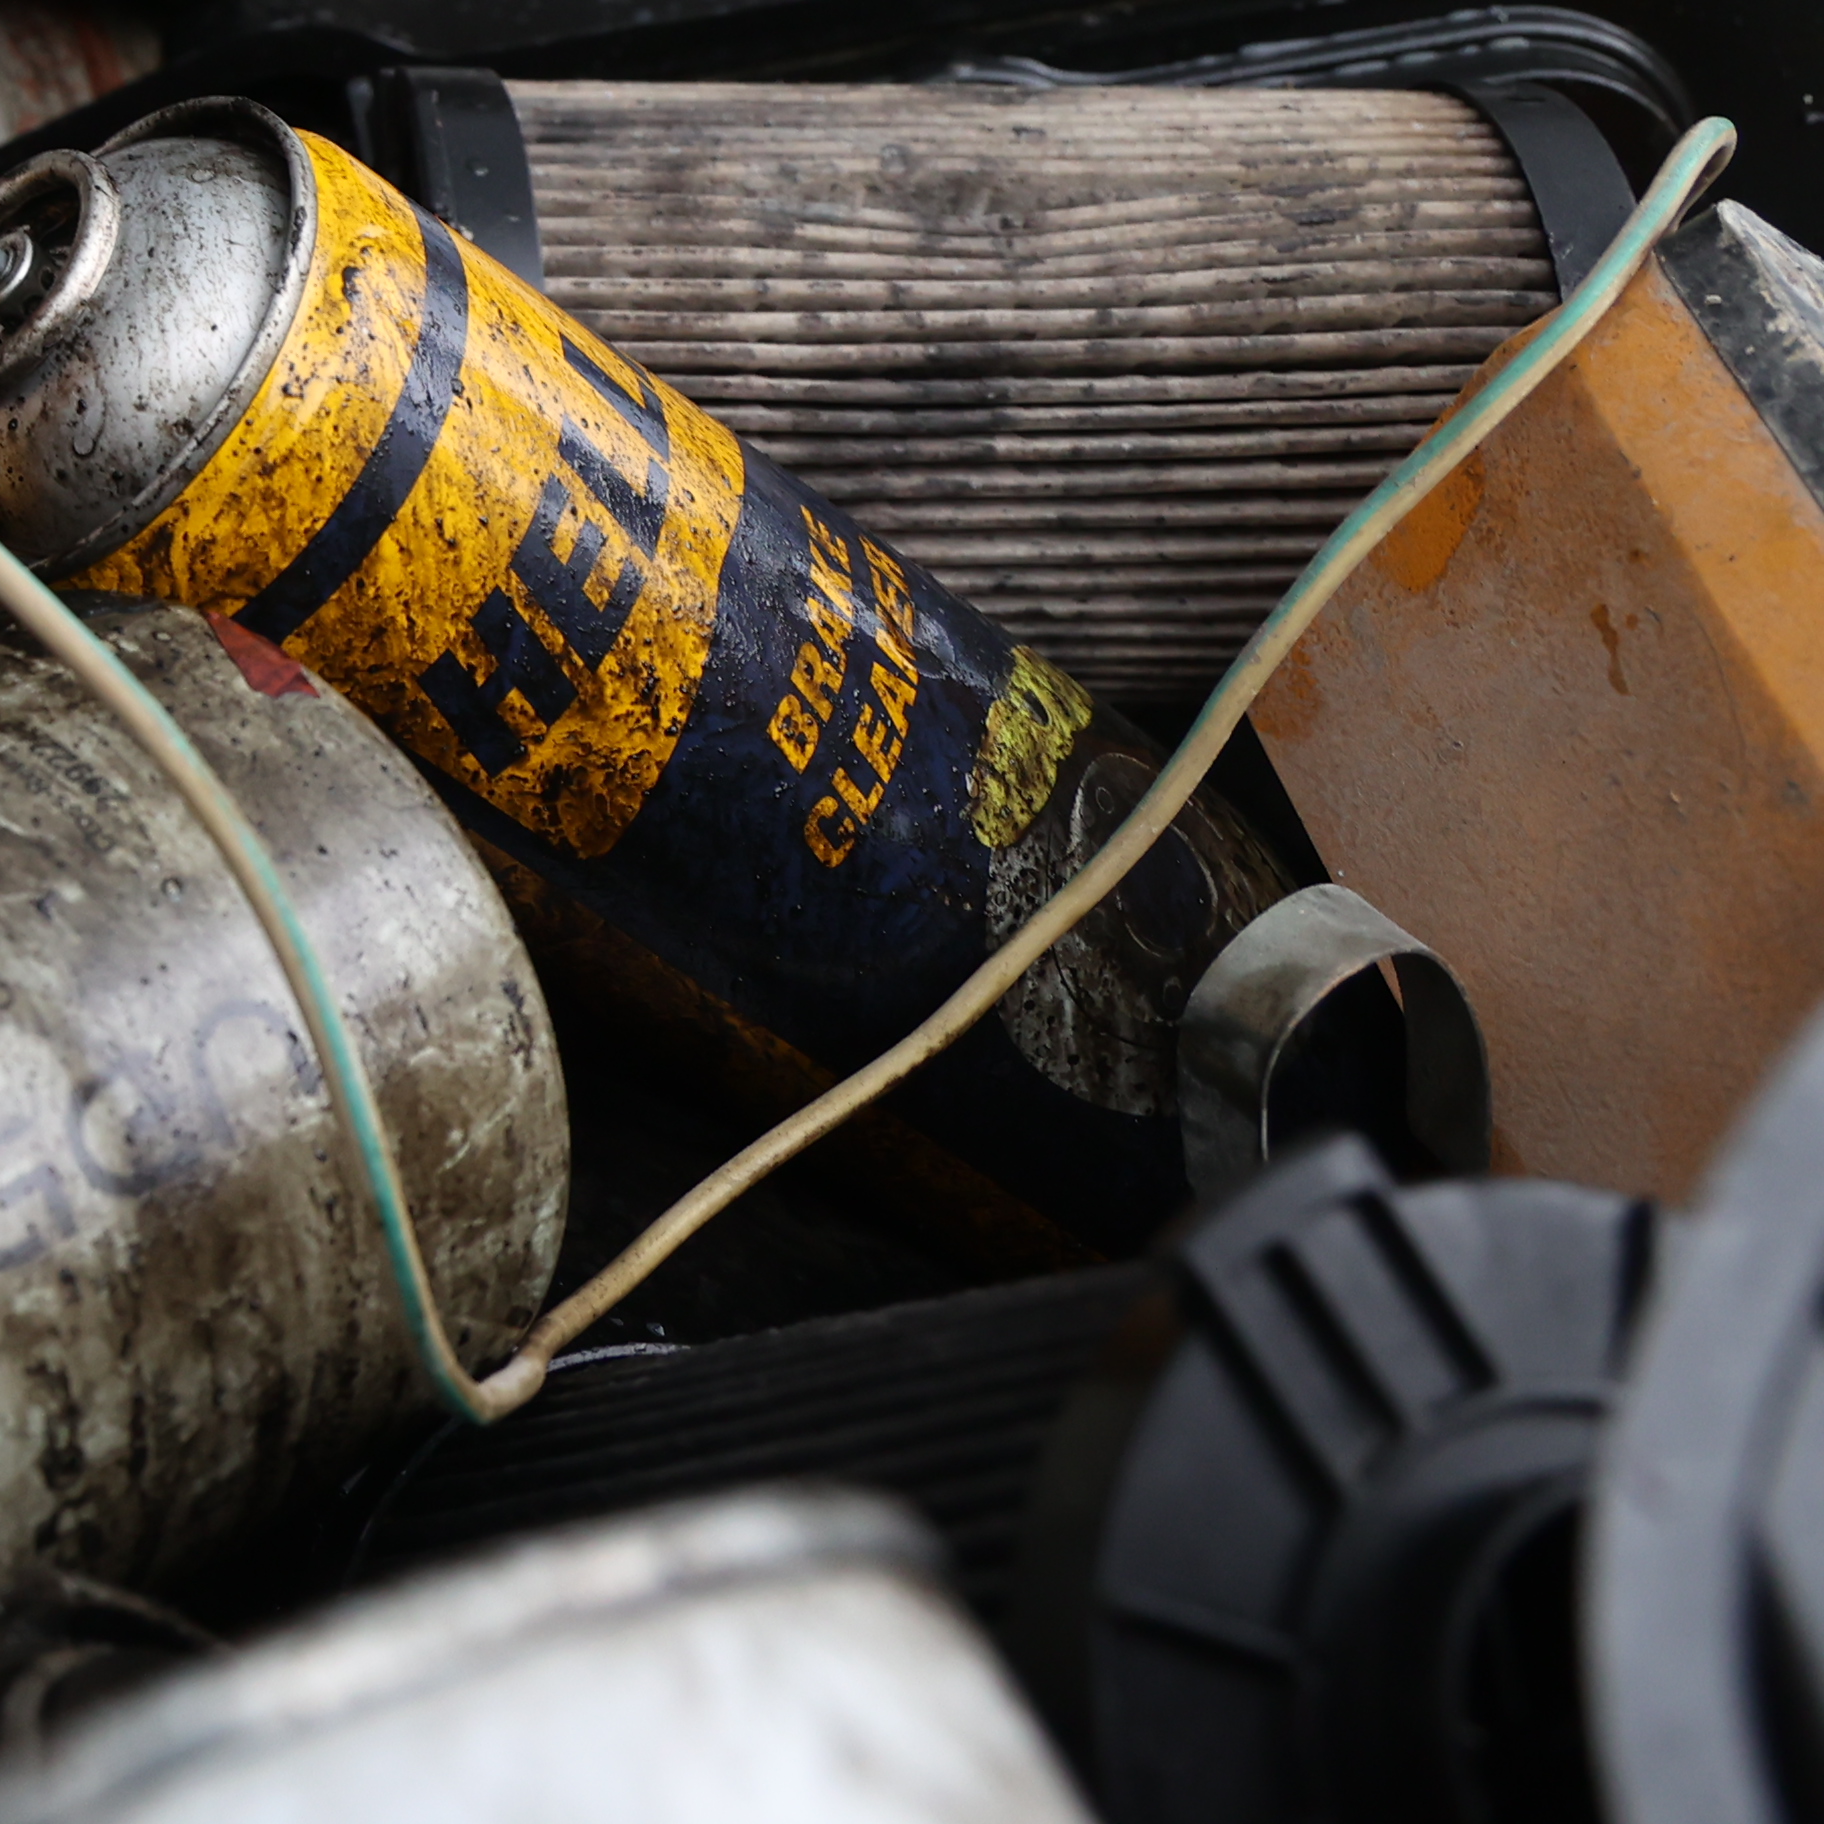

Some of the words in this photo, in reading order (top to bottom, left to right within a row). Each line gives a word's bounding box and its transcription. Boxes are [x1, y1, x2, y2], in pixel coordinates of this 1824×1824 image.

[418, 332, 671, 776] HELL
[768, 504, 854, 775] BRAKE
[803, 535, 921, 869] CLEANER
